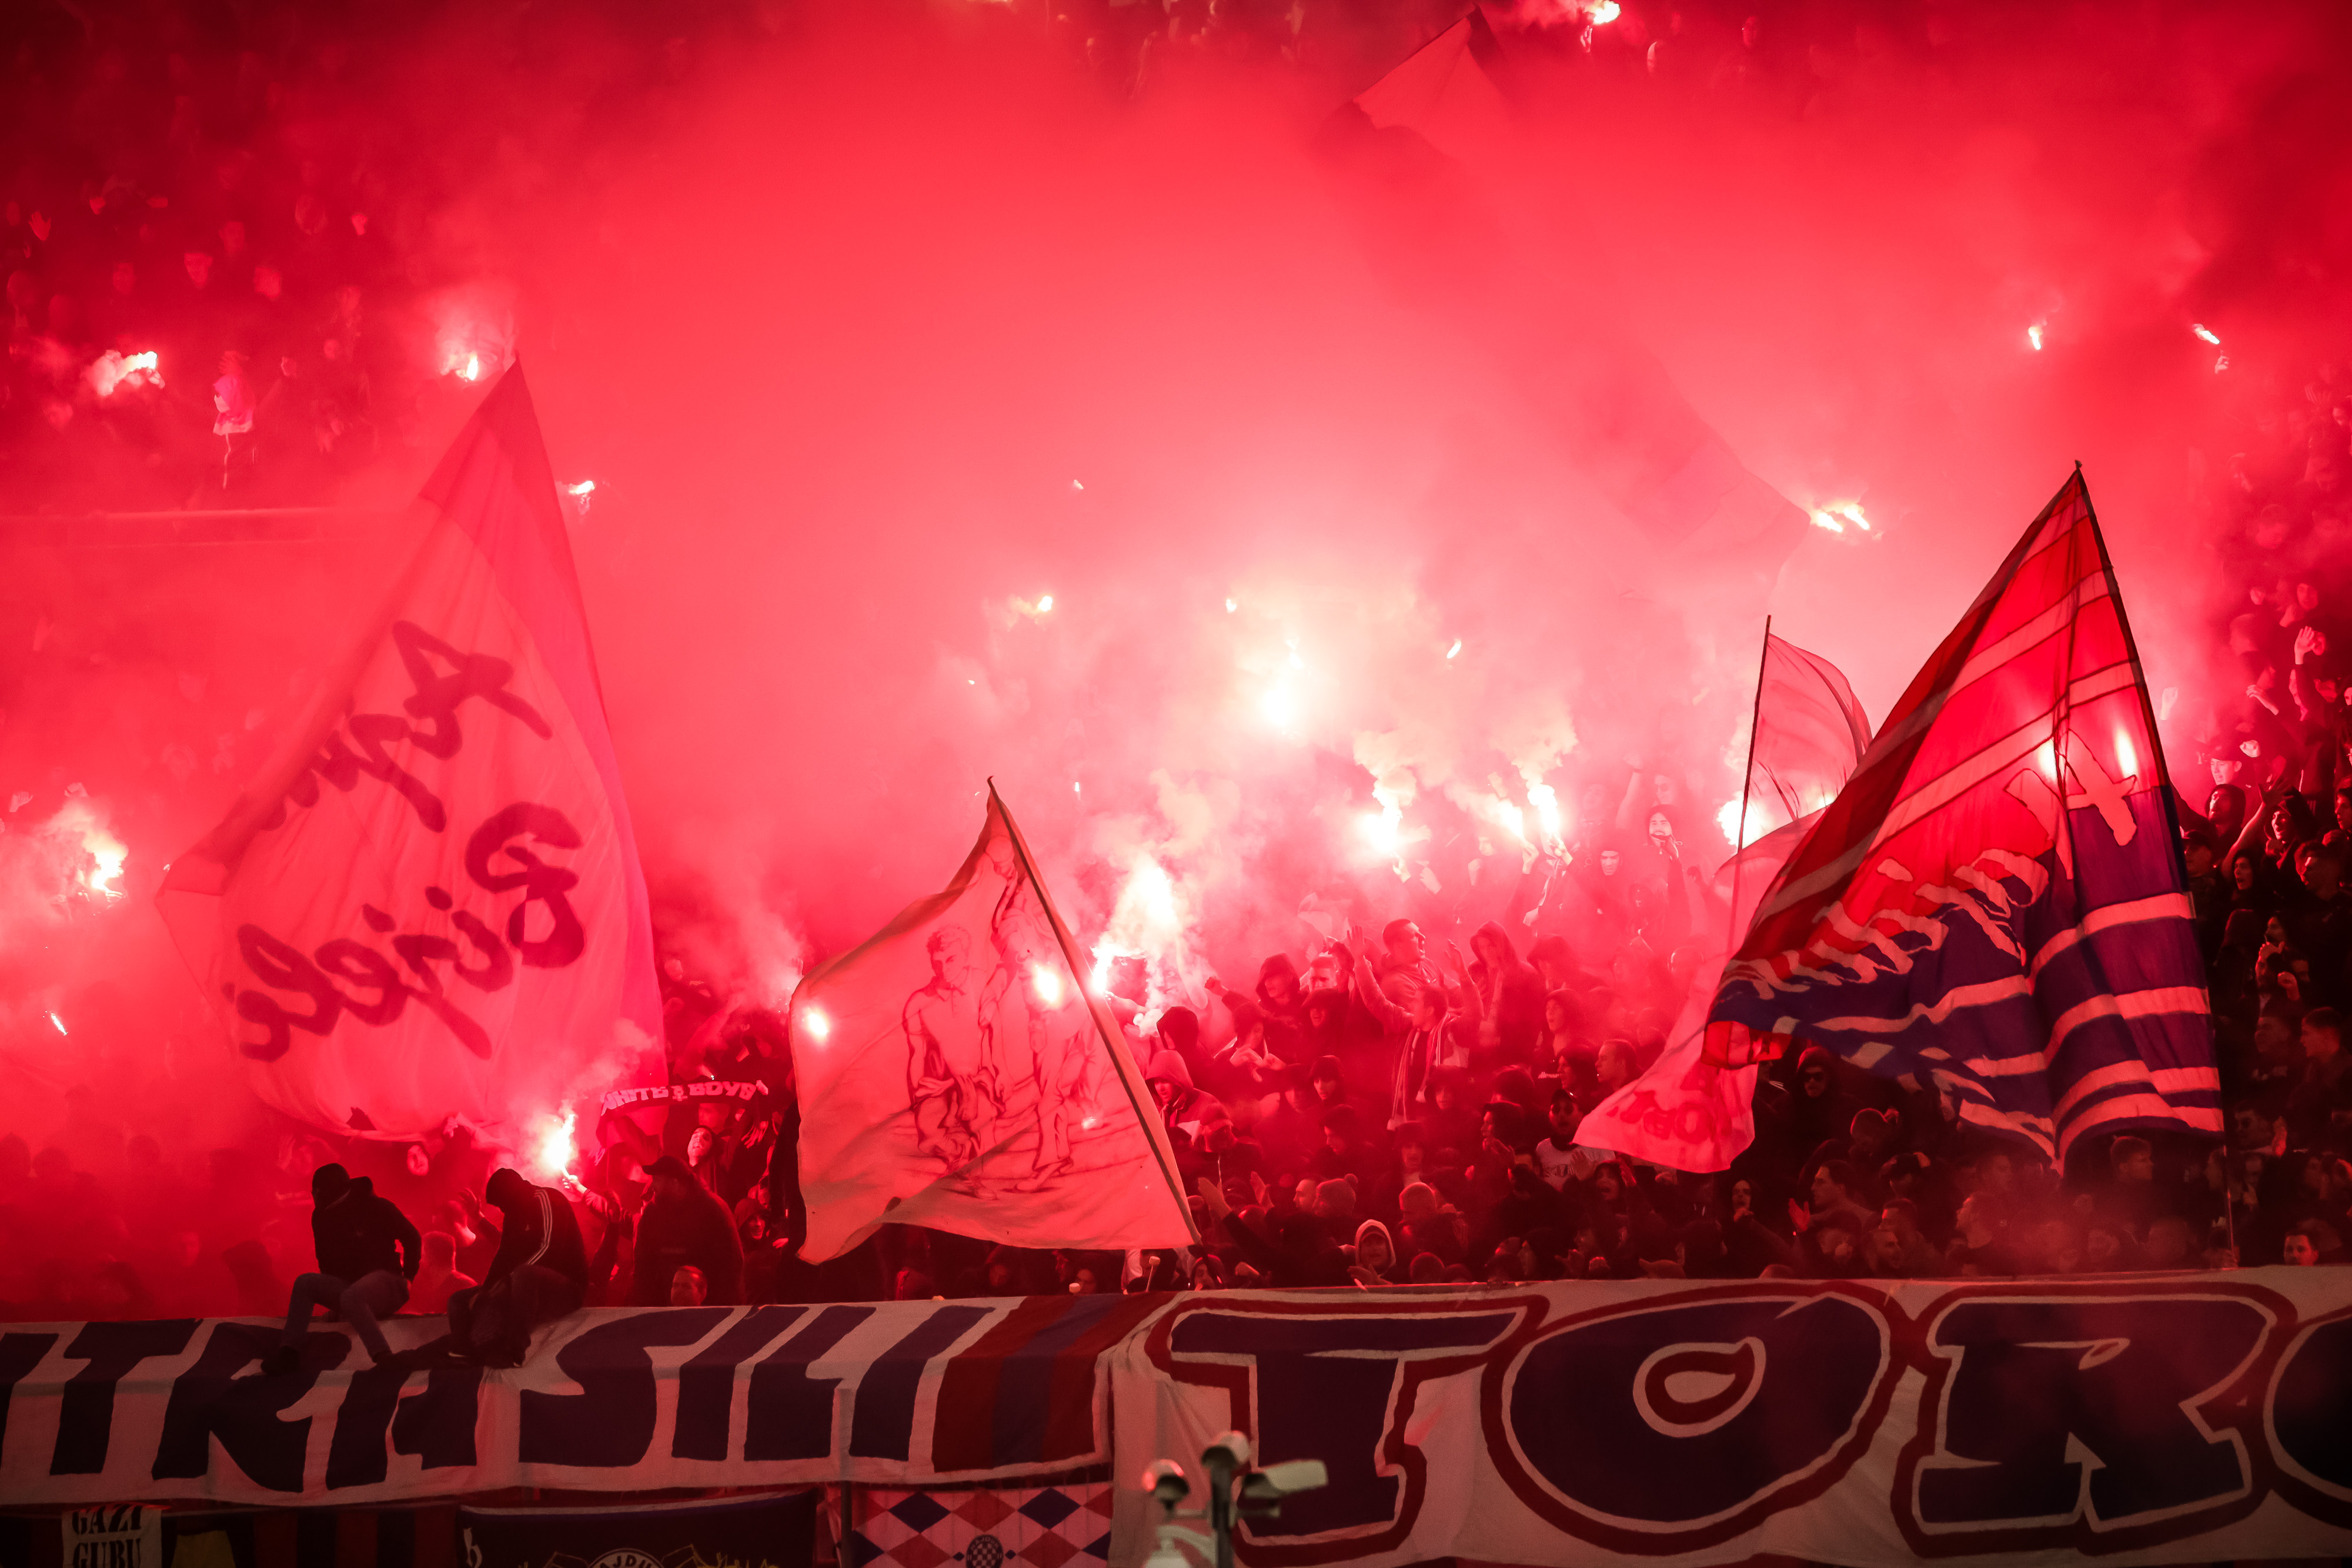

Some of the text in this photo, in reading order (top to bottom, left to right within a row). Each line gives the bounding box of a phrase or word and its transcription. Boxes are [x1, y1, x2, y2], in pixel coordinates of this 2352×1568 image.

[600, 1086, 669, 1116] WHITE
[1147, 1279, 2352, 1566] TOR
[72, 1504, 142, 1535] GAZI
